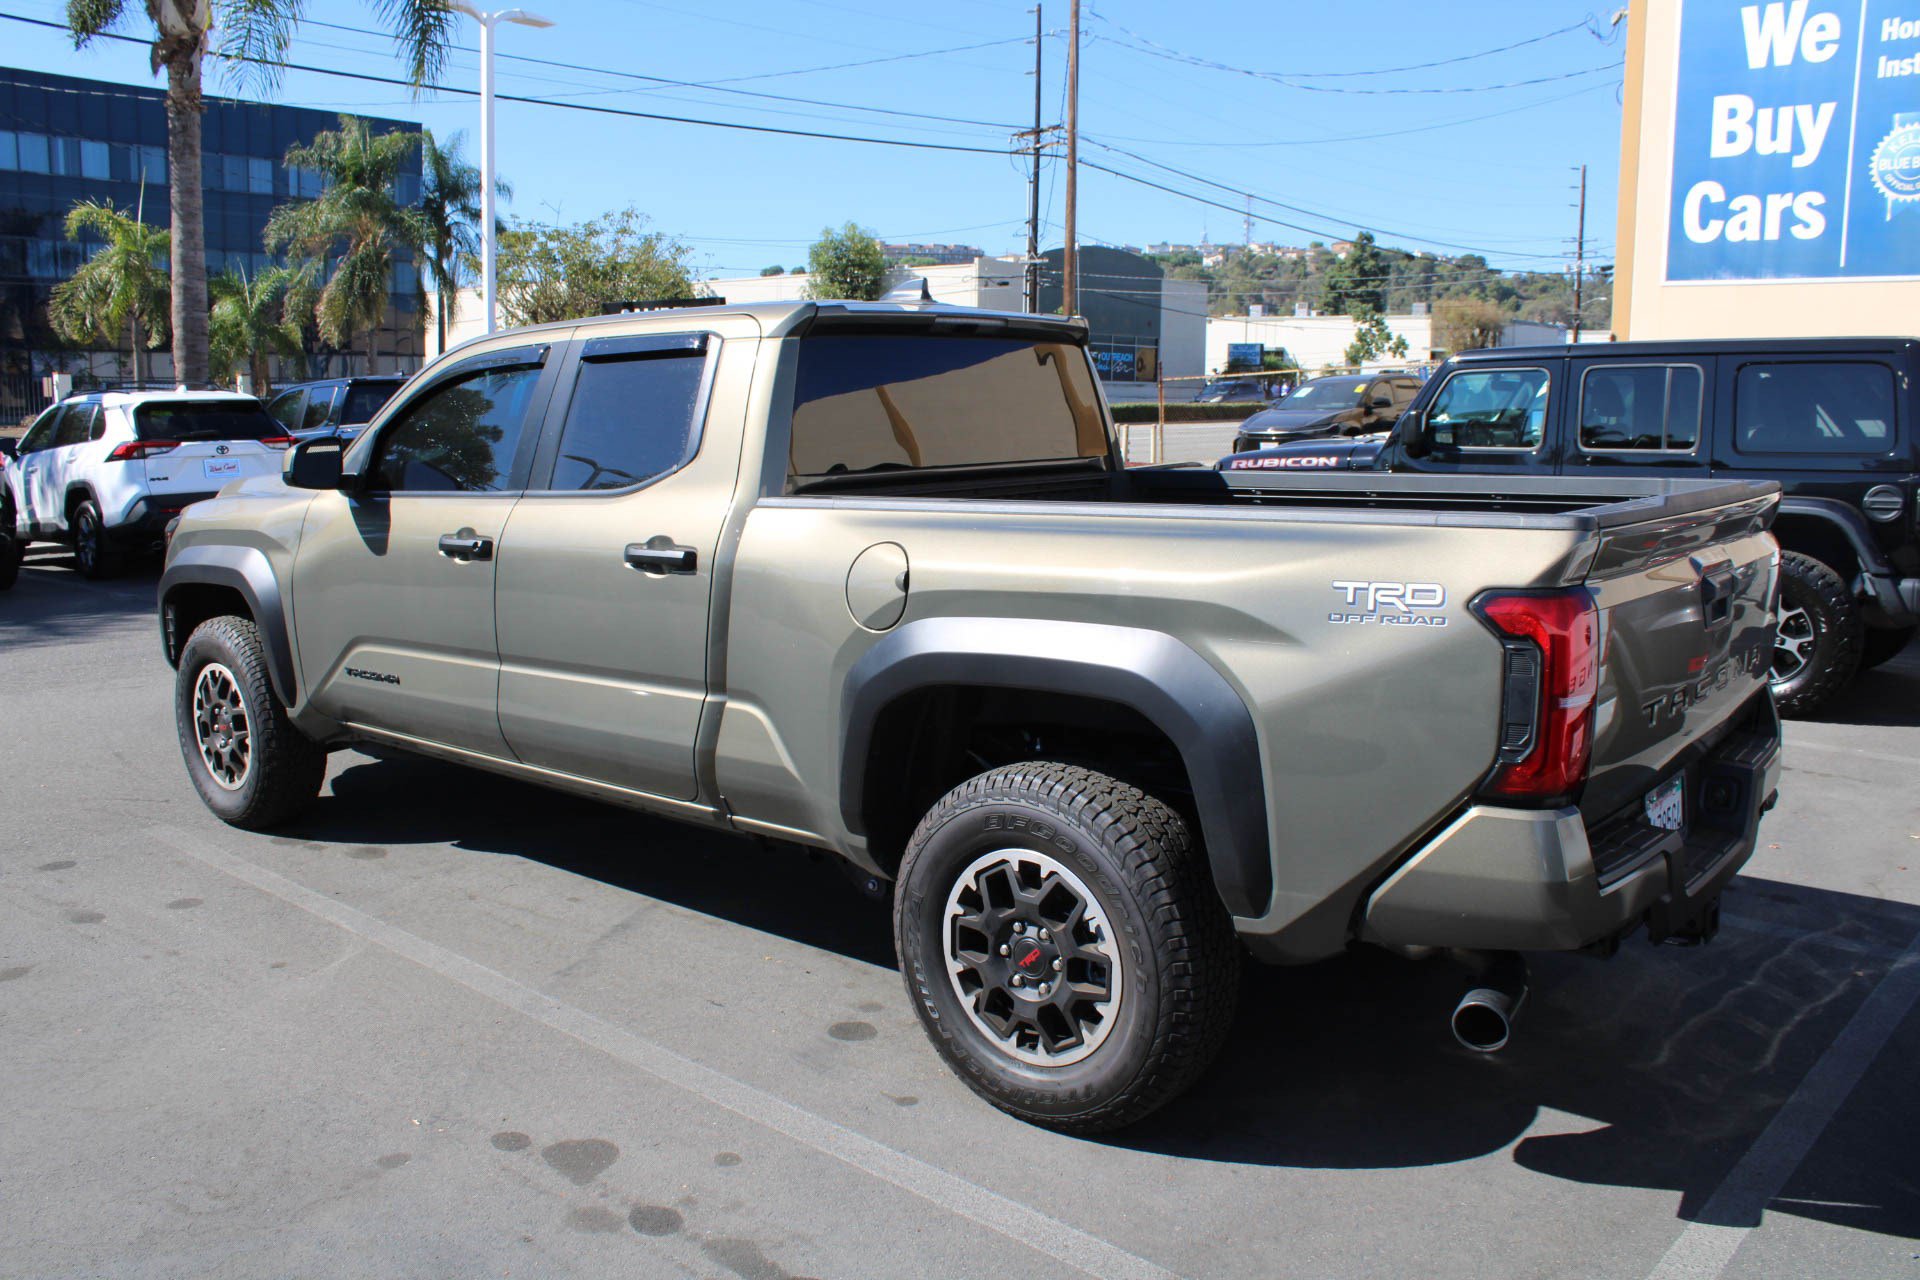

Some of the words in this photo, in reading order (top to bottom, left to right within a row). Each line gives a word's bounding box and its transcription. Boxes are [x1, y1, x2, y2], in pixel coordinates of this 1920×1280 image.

[1741, 0, 1840, 69] We
[1710, 94, 1837, 168] Buy
[1683, 181, 1826, 243] Cars
[1231, 456, 1338, 469] RUBICON
[1328, 613, 1376, 625] OFF
[1380, 614, 1448, 628] ROAD
[1332, 580, 1446, 613] TRD
[1642, 644, 1761, 729] TACOMA
